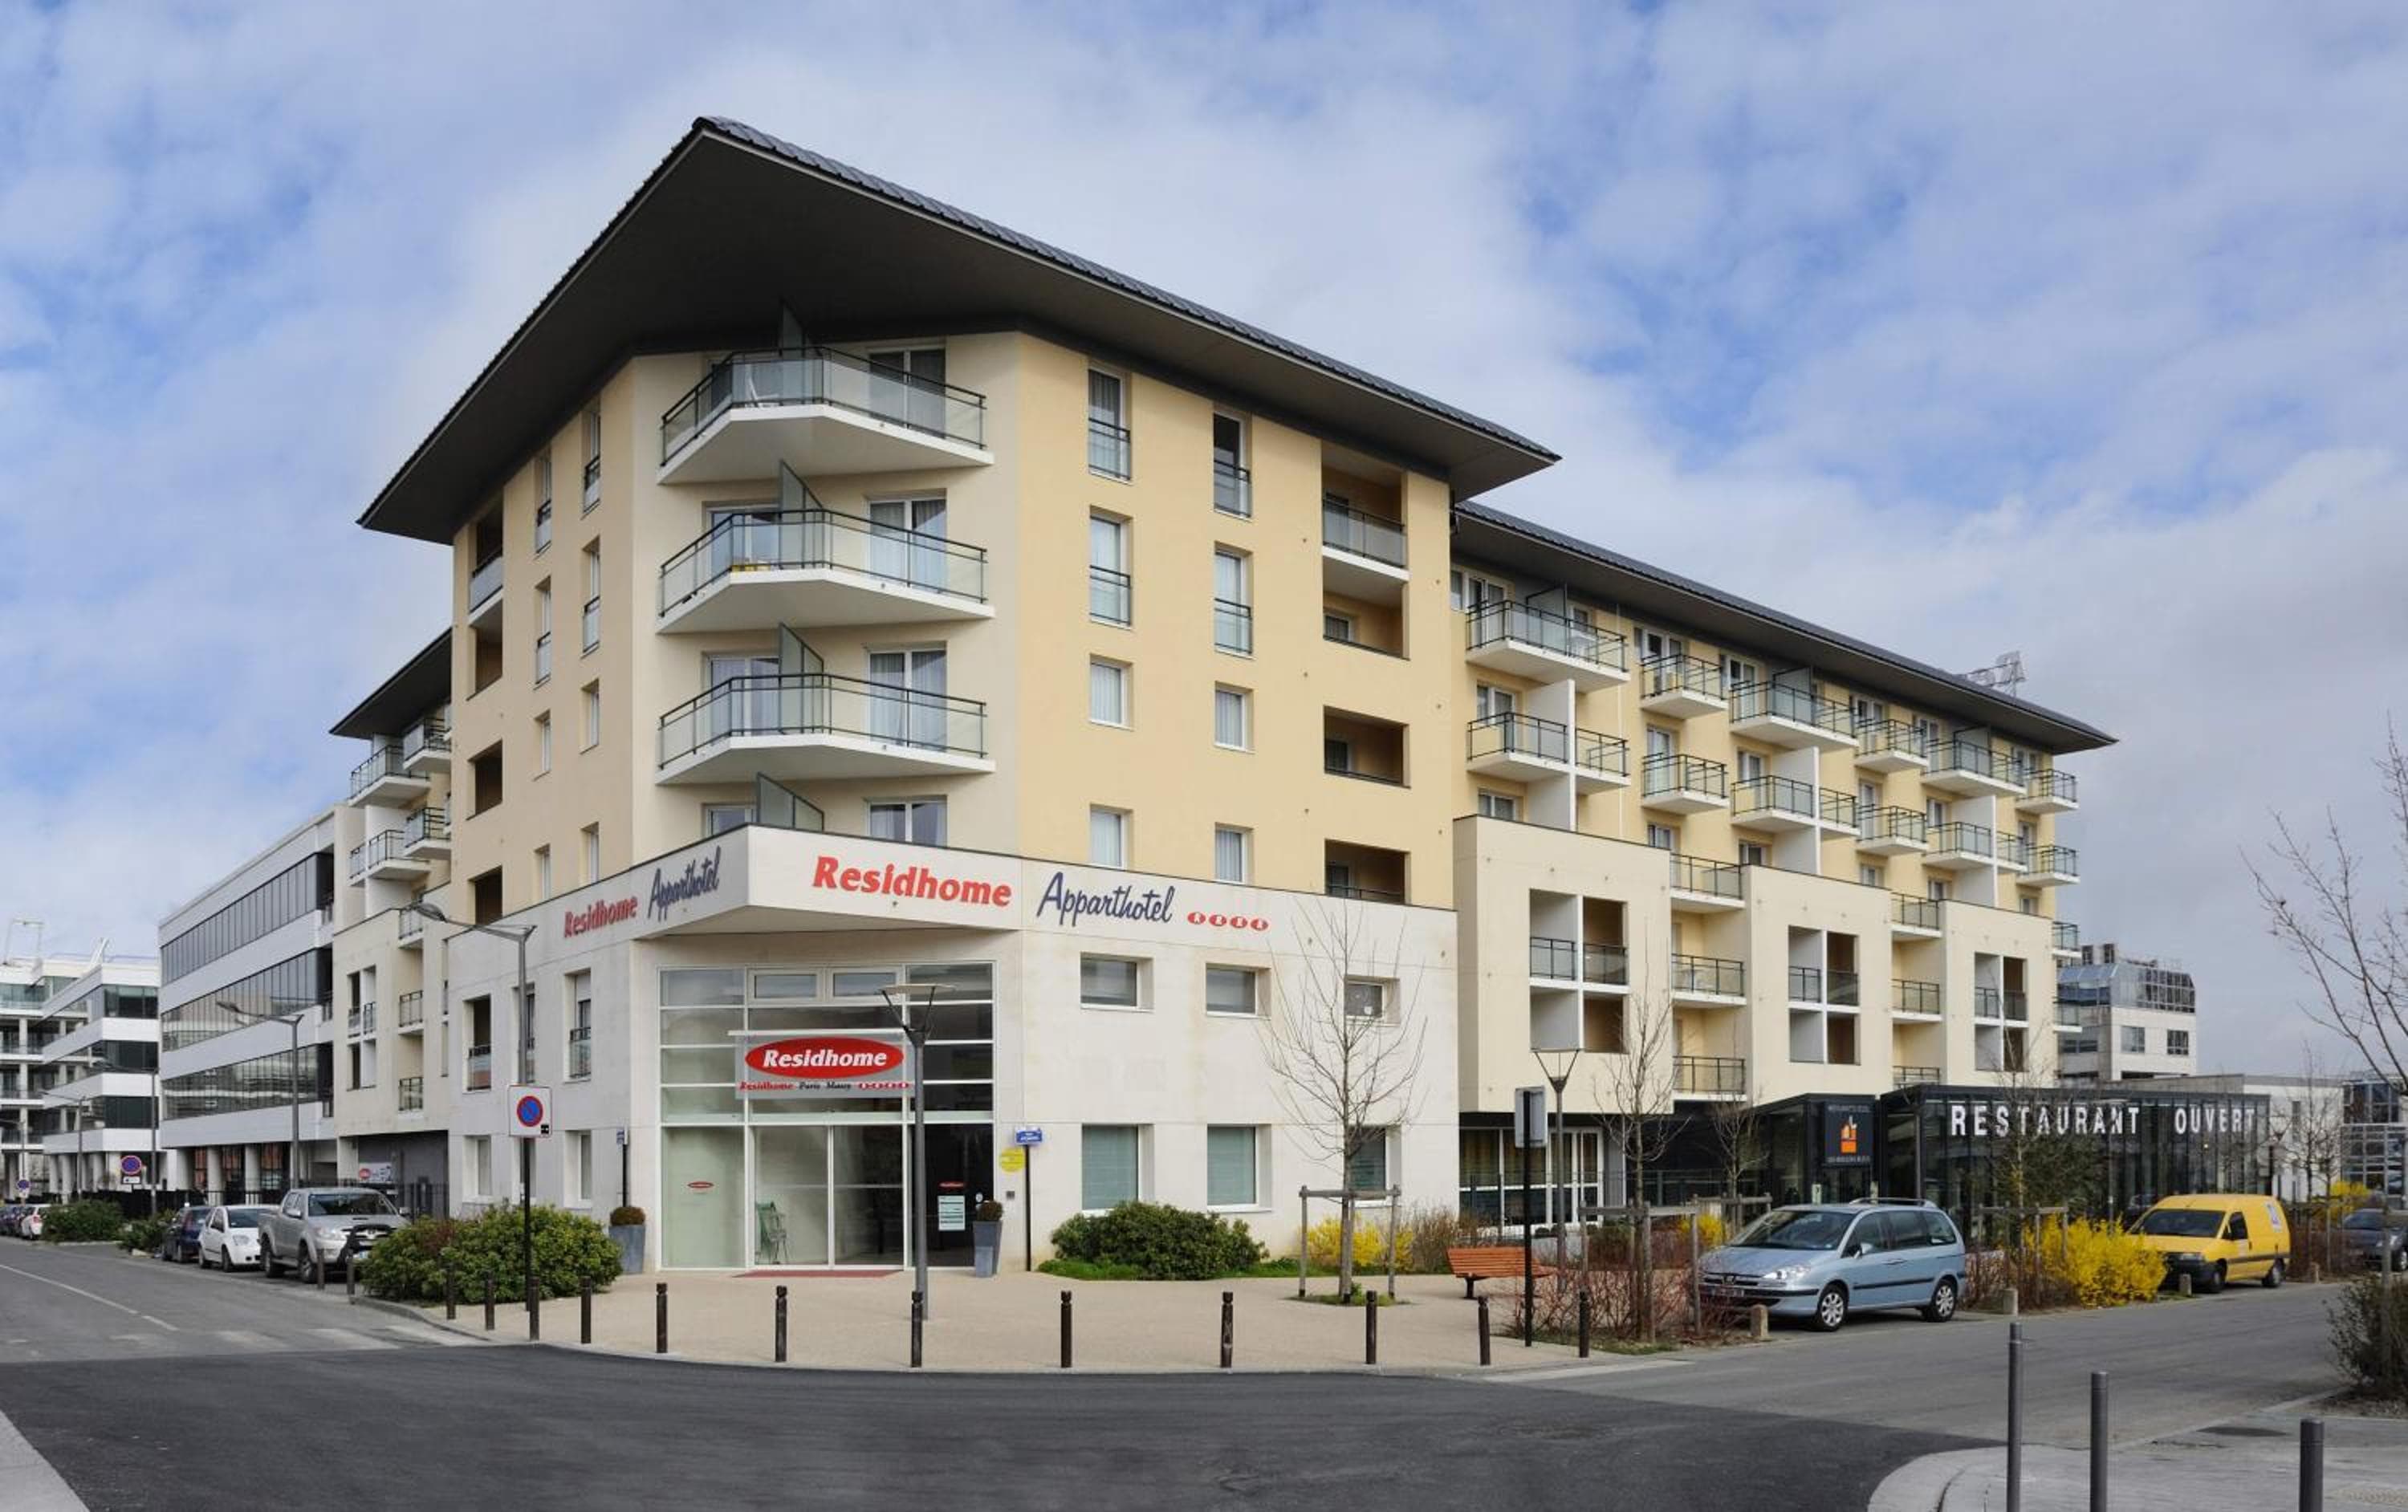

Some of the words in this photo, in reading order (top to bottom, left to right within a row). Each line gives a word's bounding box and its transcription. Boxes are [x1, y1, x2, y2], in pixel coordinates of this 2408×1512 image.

[812, 856, 1011, 907] Residhome
[1036, 872, 1175, 927] Apparthotel
[564, 895, 638, 938] Residhome
[763, 1049, 887, 1067] Residhome
[1951, 1105, 2139, 1136] RESTAURANT
[2174, 1108, 2255, 1134] OUVERT
